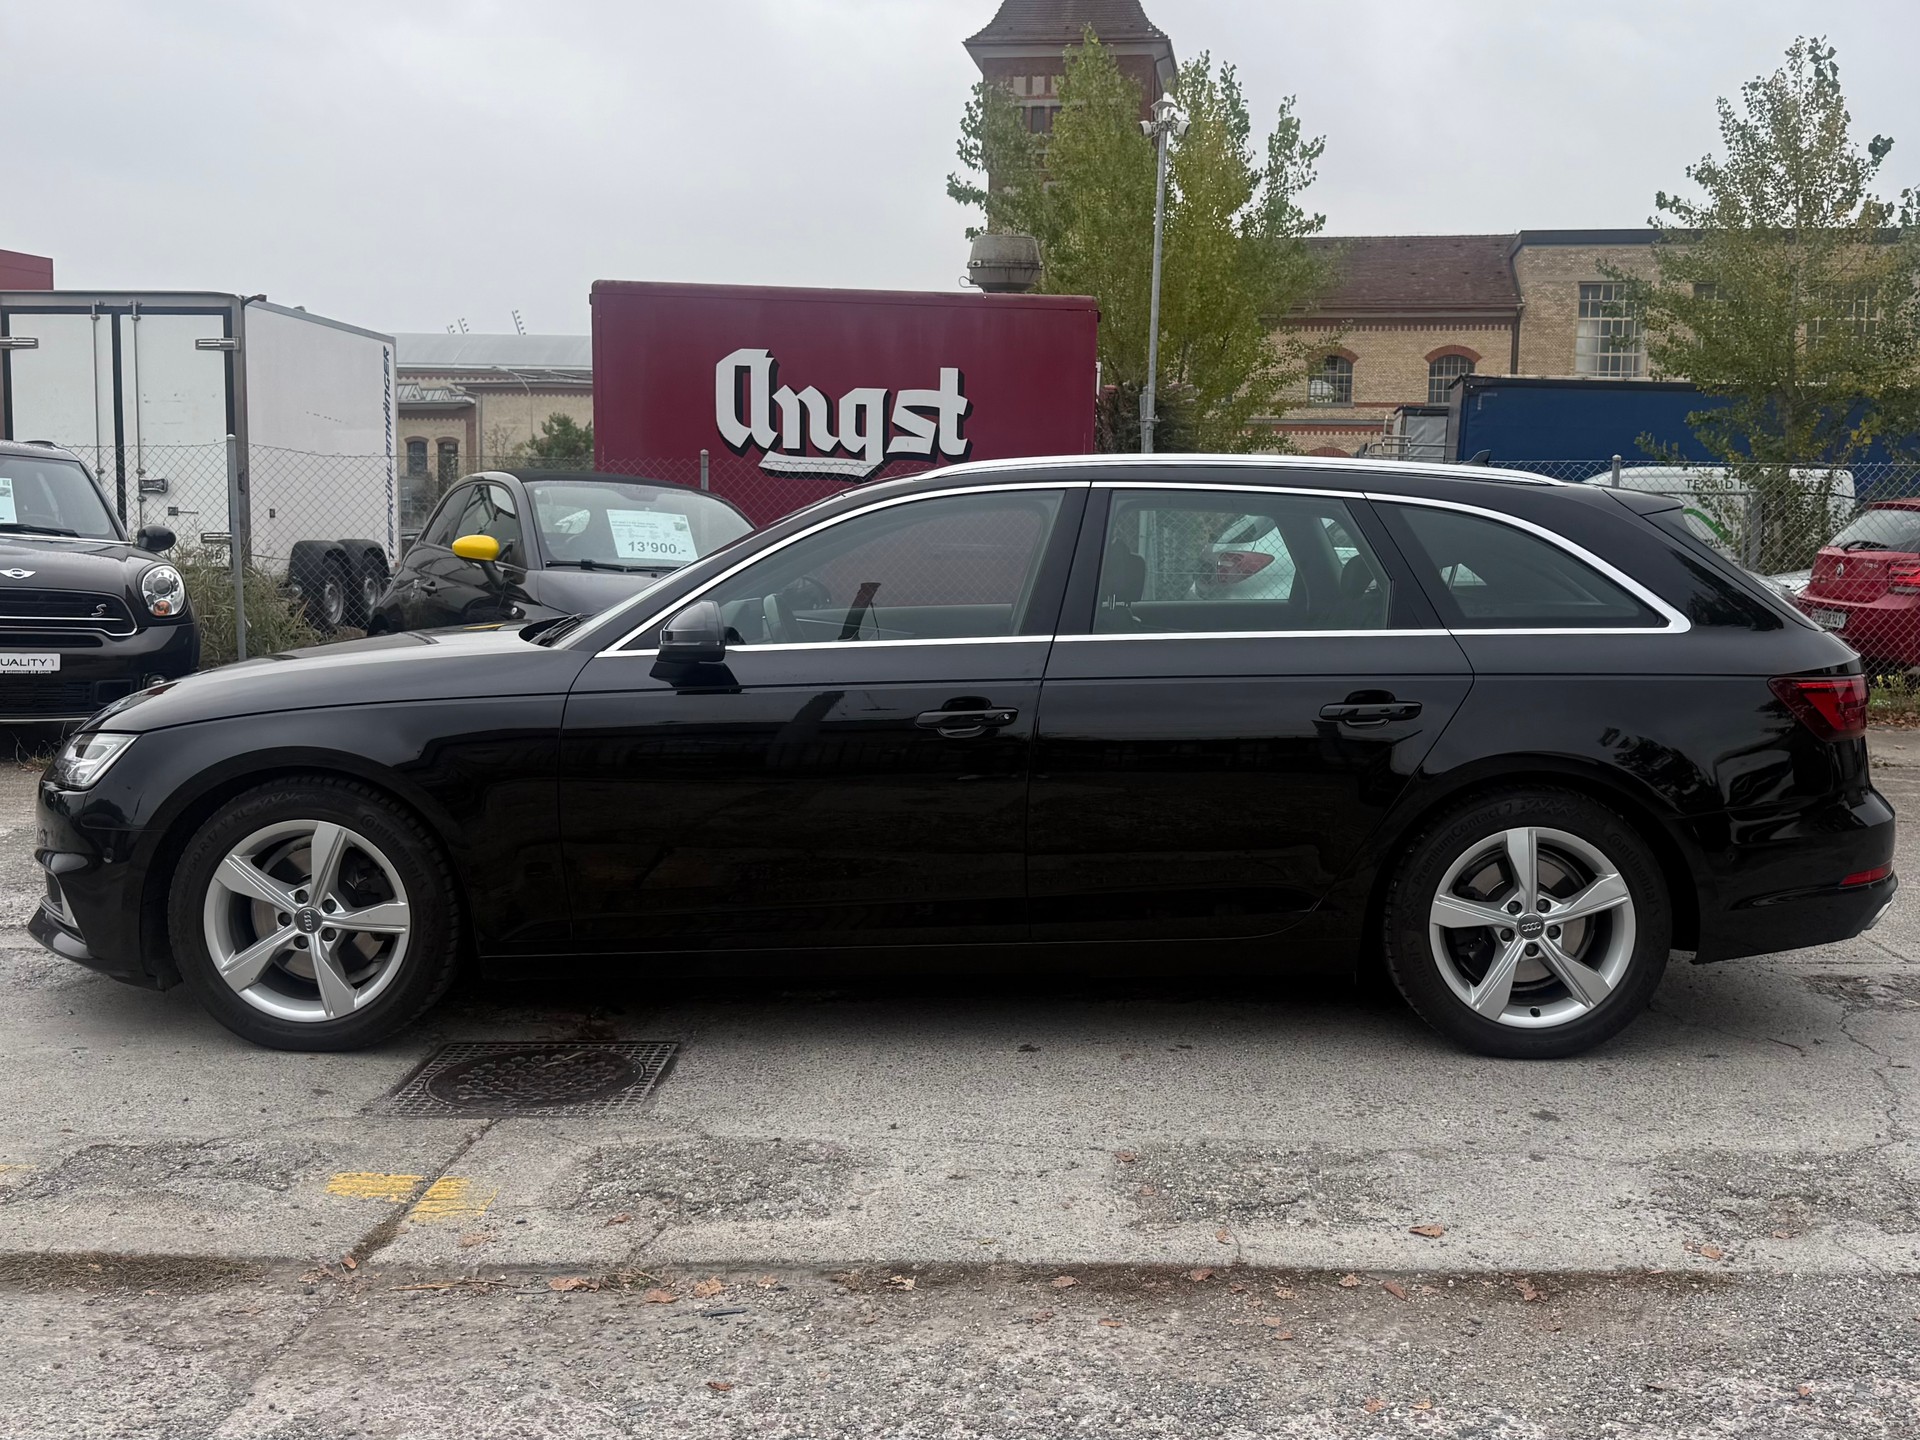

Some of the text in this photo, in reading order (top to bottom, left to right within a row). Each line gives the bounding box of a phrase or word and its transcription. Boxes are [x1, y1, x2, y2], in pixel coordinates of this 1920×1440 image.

[716, 348, 971, 479] Angst
[360, 814, 425, 880] Continental
[1415, 806, 1500, 886] PremiumContact
[1608, 832, 1659, 905] Continental
